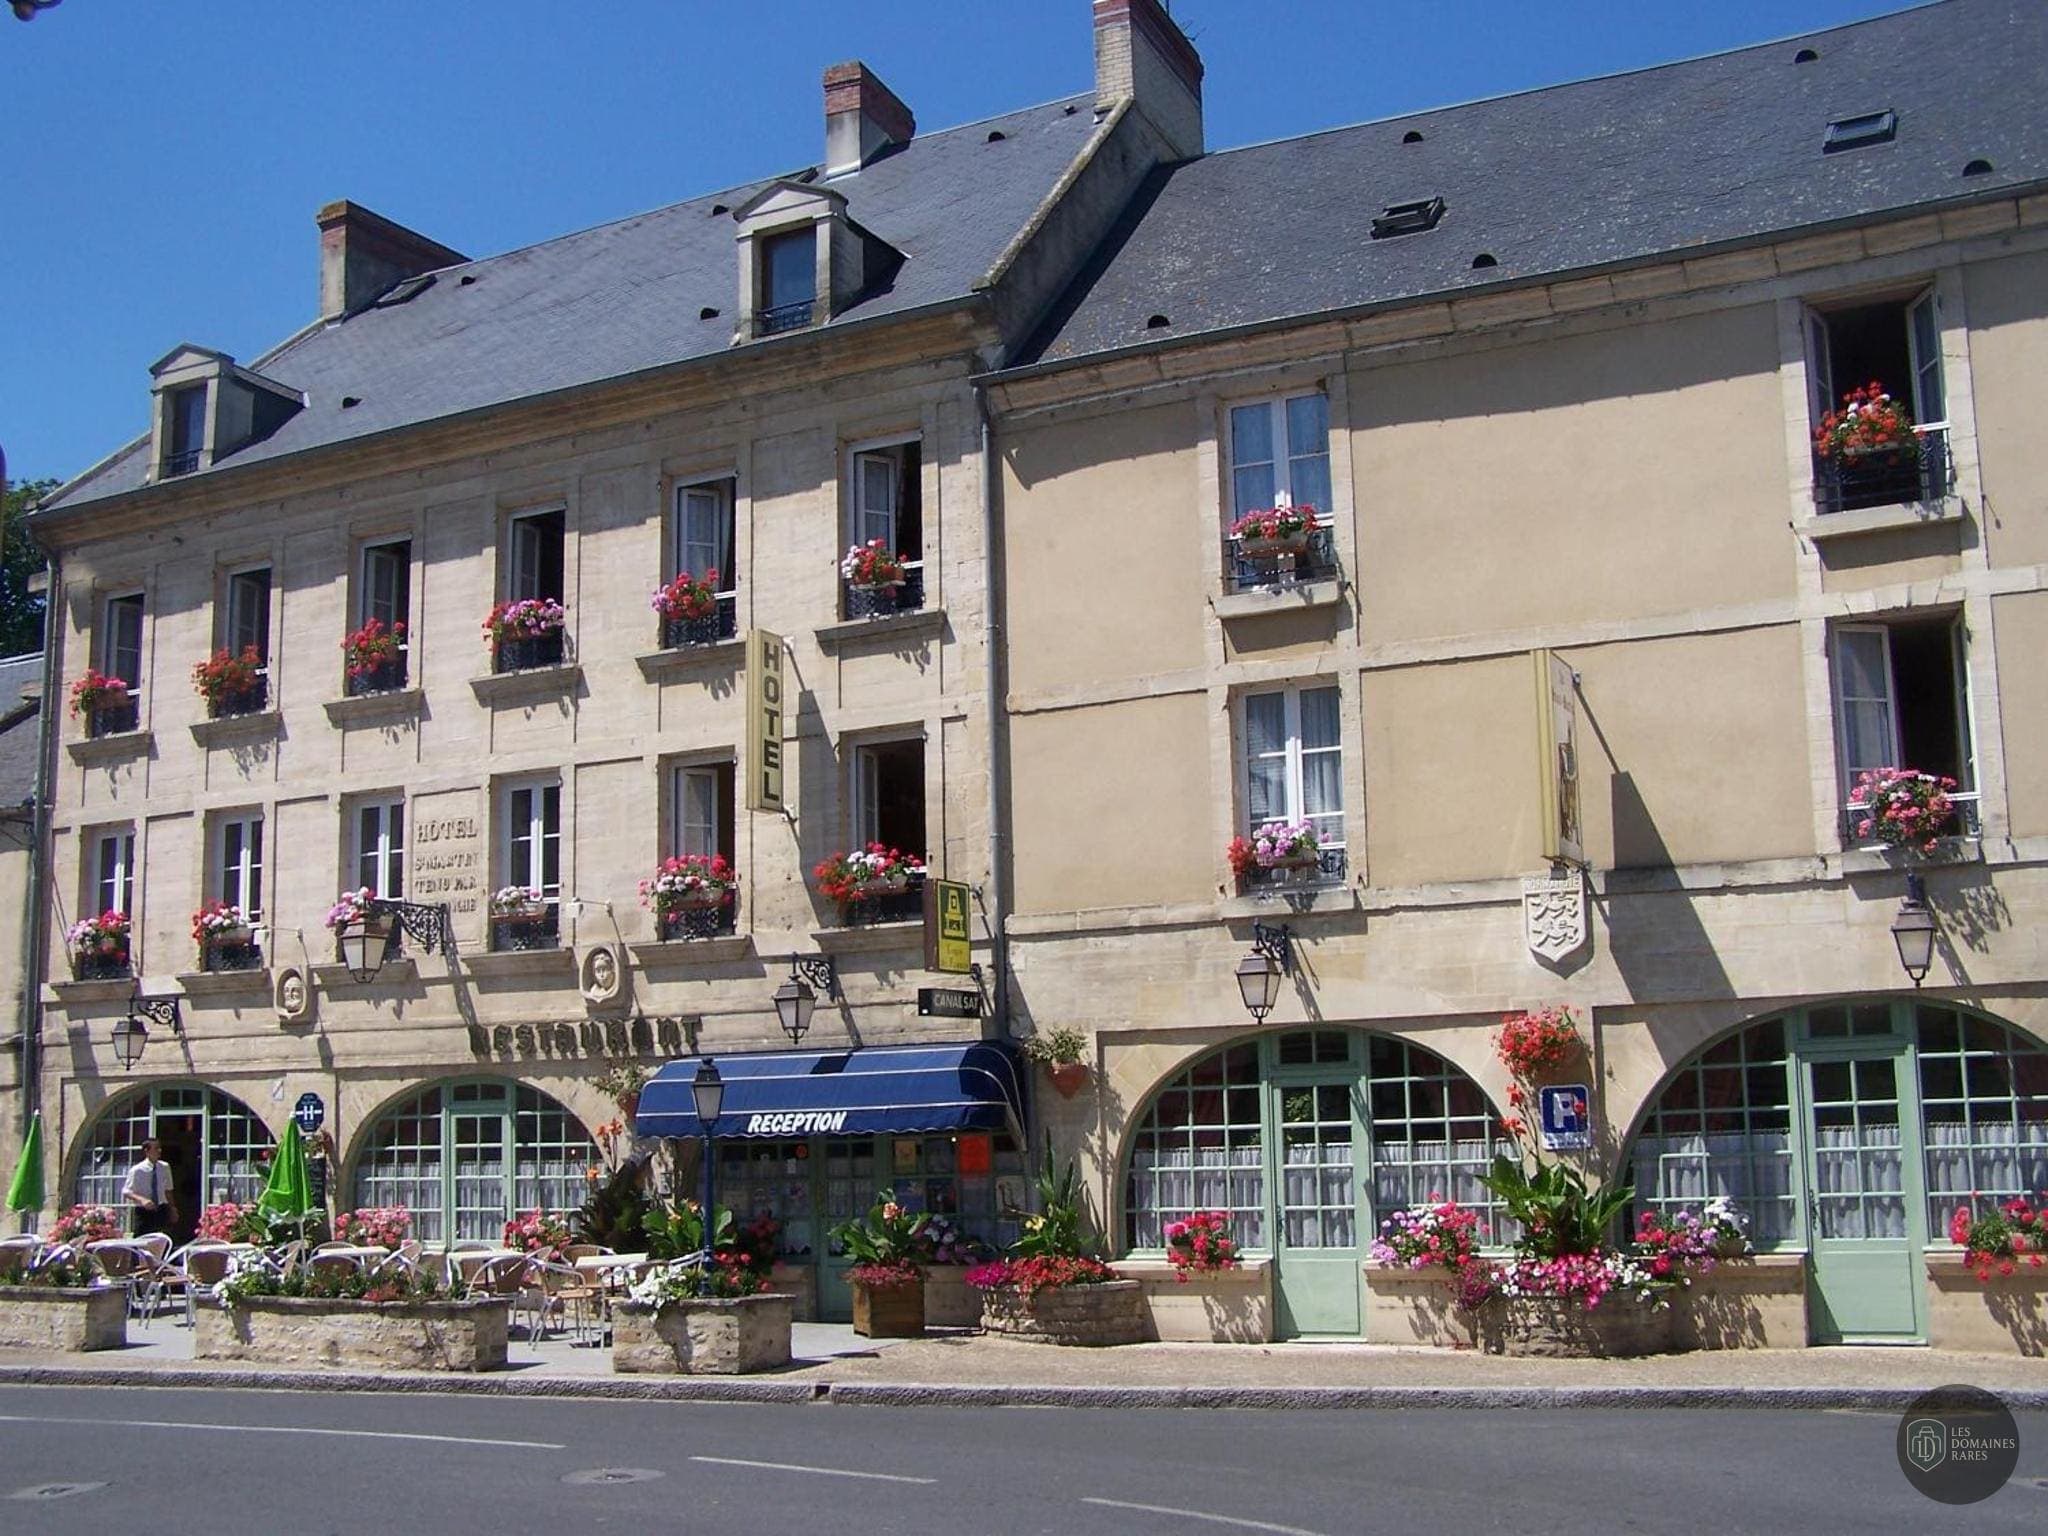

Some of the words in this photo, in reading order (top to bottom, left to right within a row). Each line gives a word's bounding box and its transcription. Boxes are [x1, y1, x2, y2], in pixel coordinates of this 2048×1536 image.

[763, 641, 780, 801] HOTEL
[468, 1015, 703, 1056] RESTAURANT
[303, 1105, 314, 1120] H
[747, 1111, 847, 1133] RECEPTION
